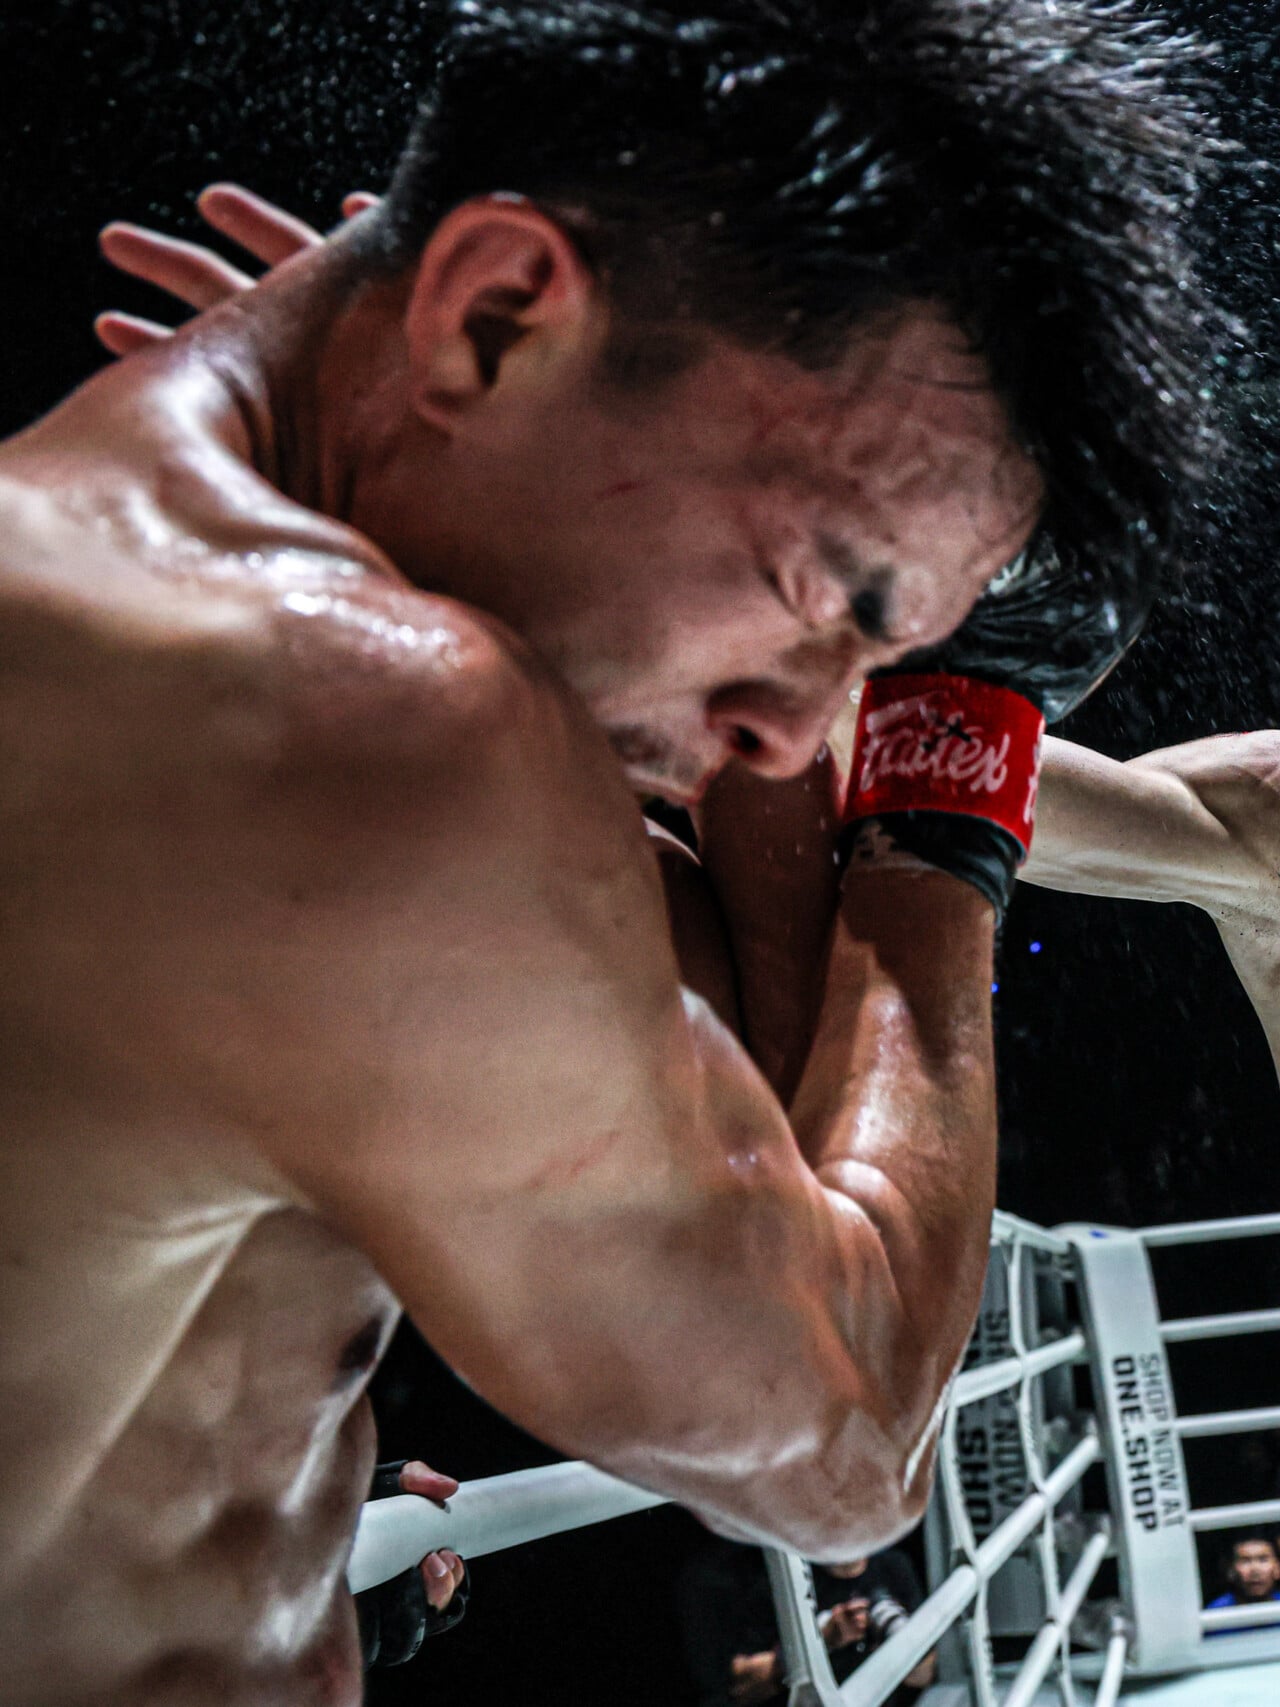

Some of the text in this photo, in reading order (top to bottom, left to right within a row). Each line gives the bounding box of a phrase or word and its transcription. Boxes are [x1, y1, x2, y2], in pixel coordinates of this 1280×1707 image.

[1113, 1356, 1157, 1531] ONE.SHOP
[1138, 1353, 1185, 1528] SHOP NOW AT
